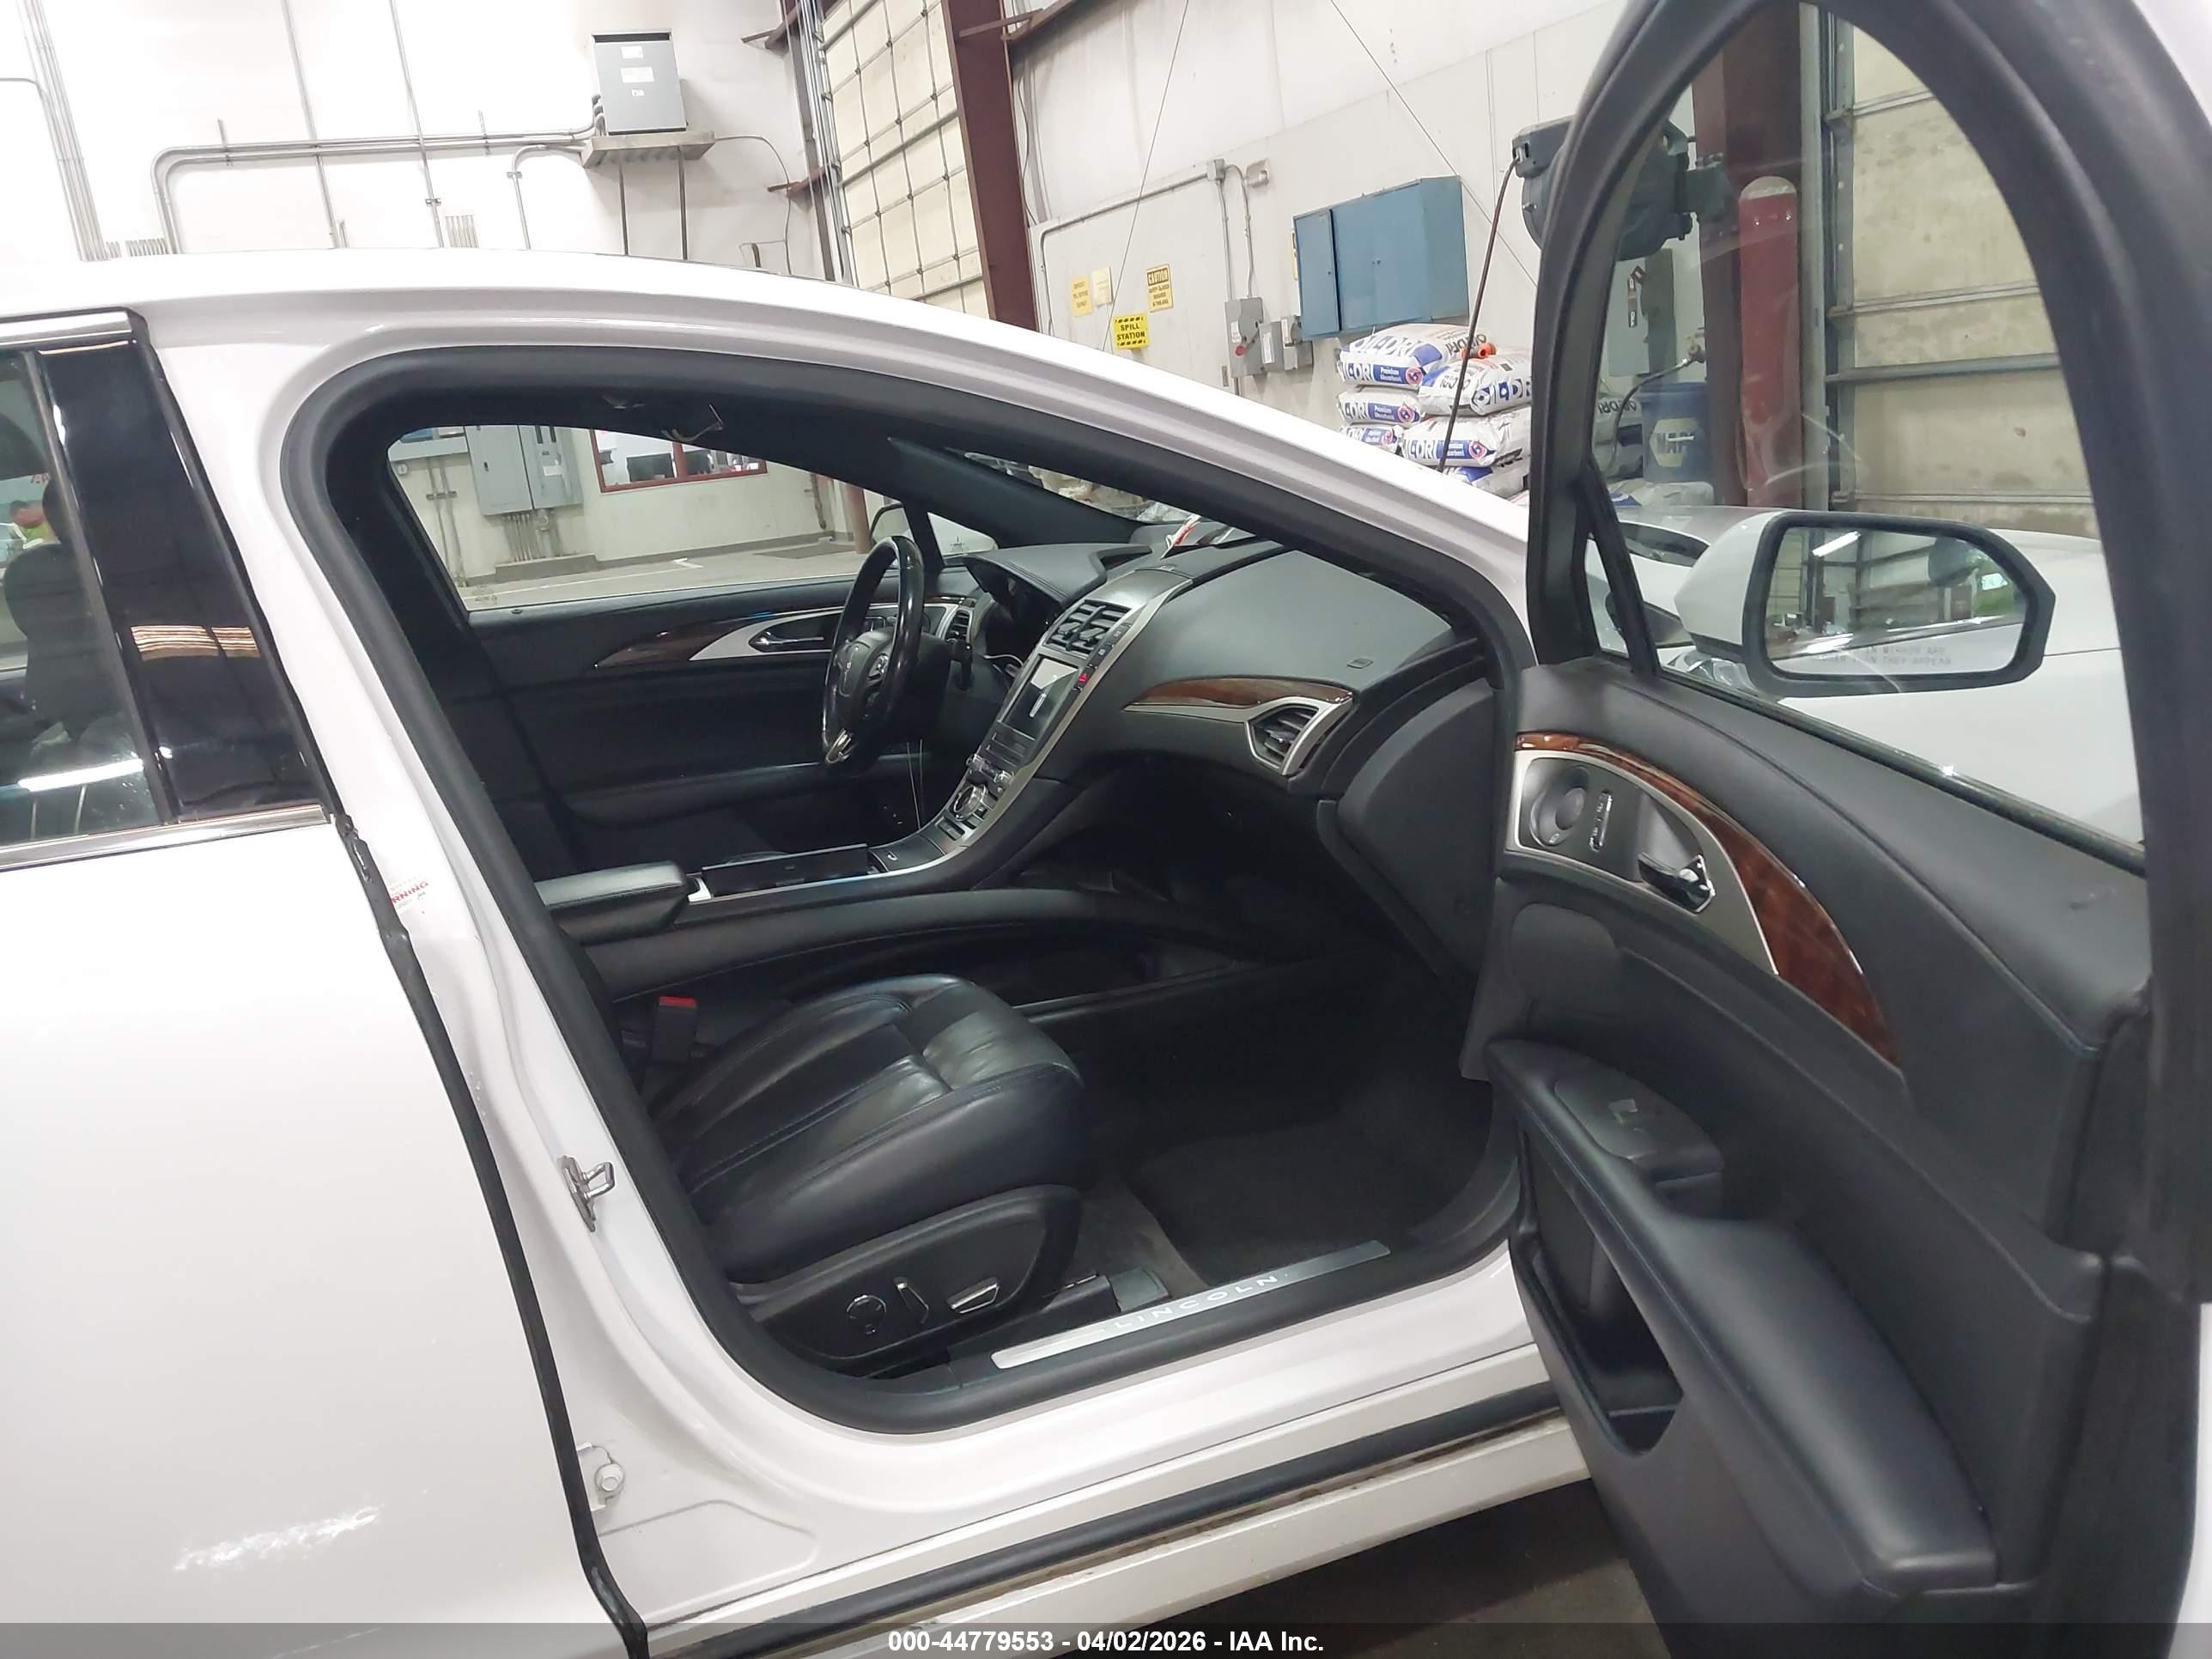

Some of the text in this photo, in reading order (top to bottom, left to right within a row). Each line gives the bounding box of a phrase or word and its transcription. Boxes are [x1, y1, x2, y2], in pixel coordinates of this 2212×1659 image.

[1120, 322, 1140, 331] SPILL
[1116, 331, 1146, 342] STATION
[1115, 1275, 1279, 1328] LINCOLN
